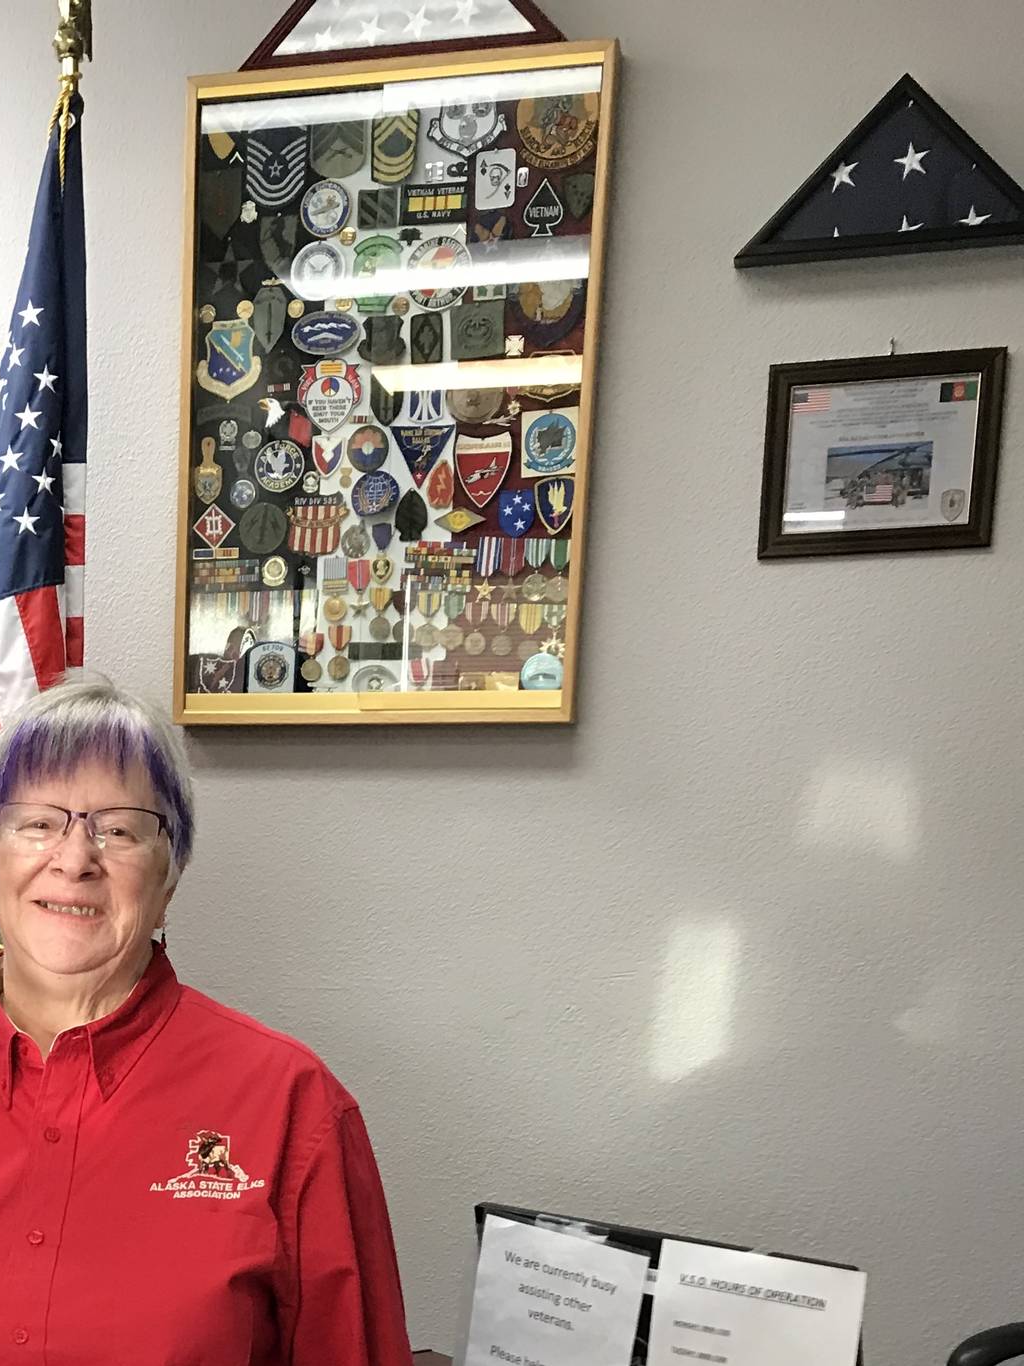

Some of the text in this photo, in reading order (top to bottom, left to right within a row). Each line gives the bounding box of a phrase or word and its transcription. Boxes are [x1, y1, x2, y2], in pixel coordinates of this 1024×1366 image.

[407, 186, 465, 197] VIETNAM VETERAN
[431, 210, 452, 218] NAVY
[528, 205, 560, 219] VIETNAM
[275, 443, 300, 460] FORCE
[260, 472, 297, 489] ACADEMY
[308, 497, 322, 505] DIV
[149, 1179, 265, 1192] ALASKA STATE ELKS
[173, 1190, 241, 1200] ASSOCIATION
[504, 1250, 618, 1295] We are currently busy
[518, 1282, 593, 1312] assisting other
[710, 1279, 746, 1295] HOURS
[747, 1286, 763, 1297] OF
[763, 1289, 826, 1309] OPERATION
[527, 1309, 575, 1332] veterans.
[489, 1344, 522, 1365] Please
